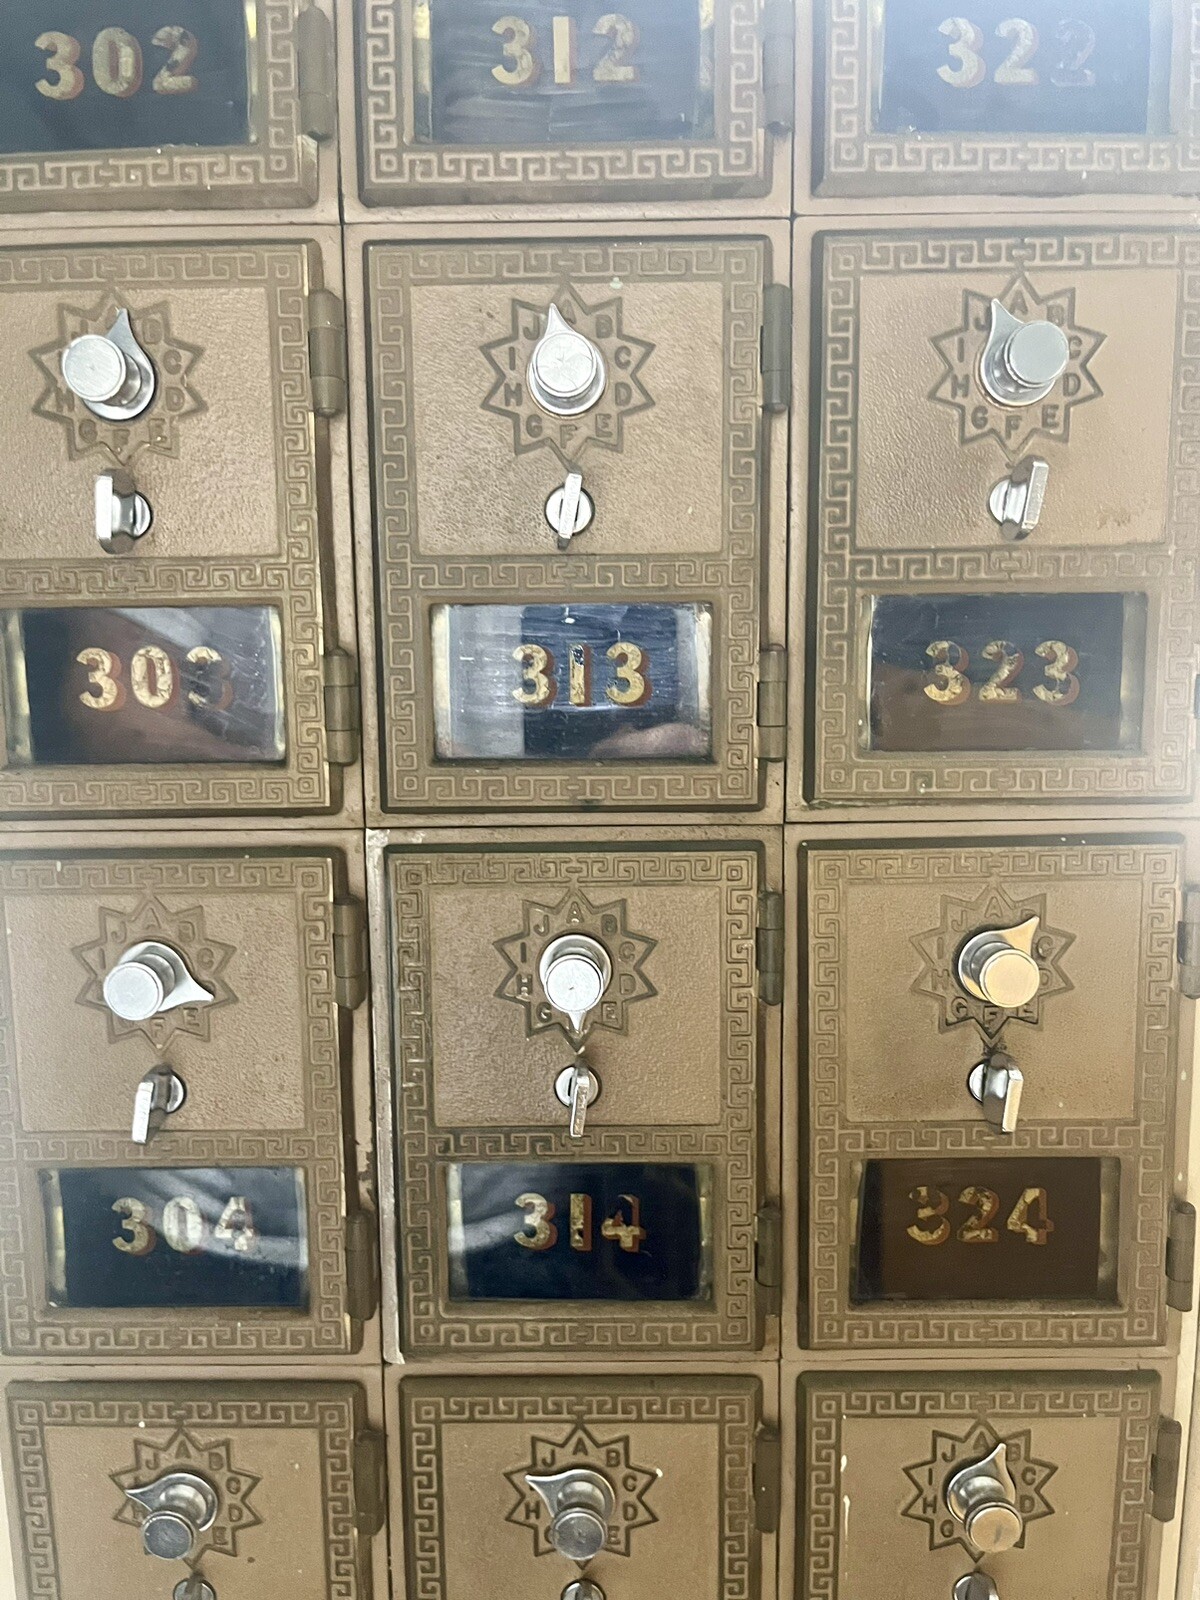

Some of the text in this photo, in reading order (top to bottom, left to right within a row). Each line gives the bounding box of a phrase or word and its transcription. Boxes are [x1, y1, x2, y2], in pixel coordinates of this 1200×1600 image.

[491, 13, 640, 86] 312
[936, 16, 1096, 88] 322
[34, 25, 199, 100] 302
[1011, 290, 1028, 314] A
[974, 306, 992, 331] J
[957, 337, 964, 362] I
[163, 350, 182, 375] C
[504, 300, 632, 448] A B C D E F G H I J
[951, 374, 969, 399] H
[1063, 373, 1080, 396] D
[165, 386, 184, 411] D
[971, 406, 988, 429] G
[1006, 415, 1022, 439] F
[1042, 405, 1059, 428] E
[76, 645, 233, 712] 303
[512, 642, 652, 708] 313
[923, 640, 1080, 705] 323
[984, 896, 1003, 917] A
[111, 921, 126, 943] J
[952, 910, 966, 932] J
[937, 937, 944, 959] I
[1037, 936, 1054, 958] C
[517, 901, 636, 1023] A B C D E G H I J
[931, 969, 949, 990] H
[183, 1007, 200, 1026] E
[111, 1196, 258, 1256] 304
[514, 1193, 646, 1252] 314
[907, 1186, 1054, 1245] 324
[175, 1441, 190, 1458] A
[942, 1444, 955, 1462] J
[973, 1431, 989, 1453] A
[1006, 1443, 1021, 1461] B
[146, 1452, 158, 1470] J
[928, 1468, 933, 1485] I
[1021, 1467, 1036, 1485] C
[525, 1438, 638, 1545] A B C D E H J
[228, 1503, 242, 1522] D
[923, 1496, 937, 1514] H
[1020, 1495, 1035, 1513] D
